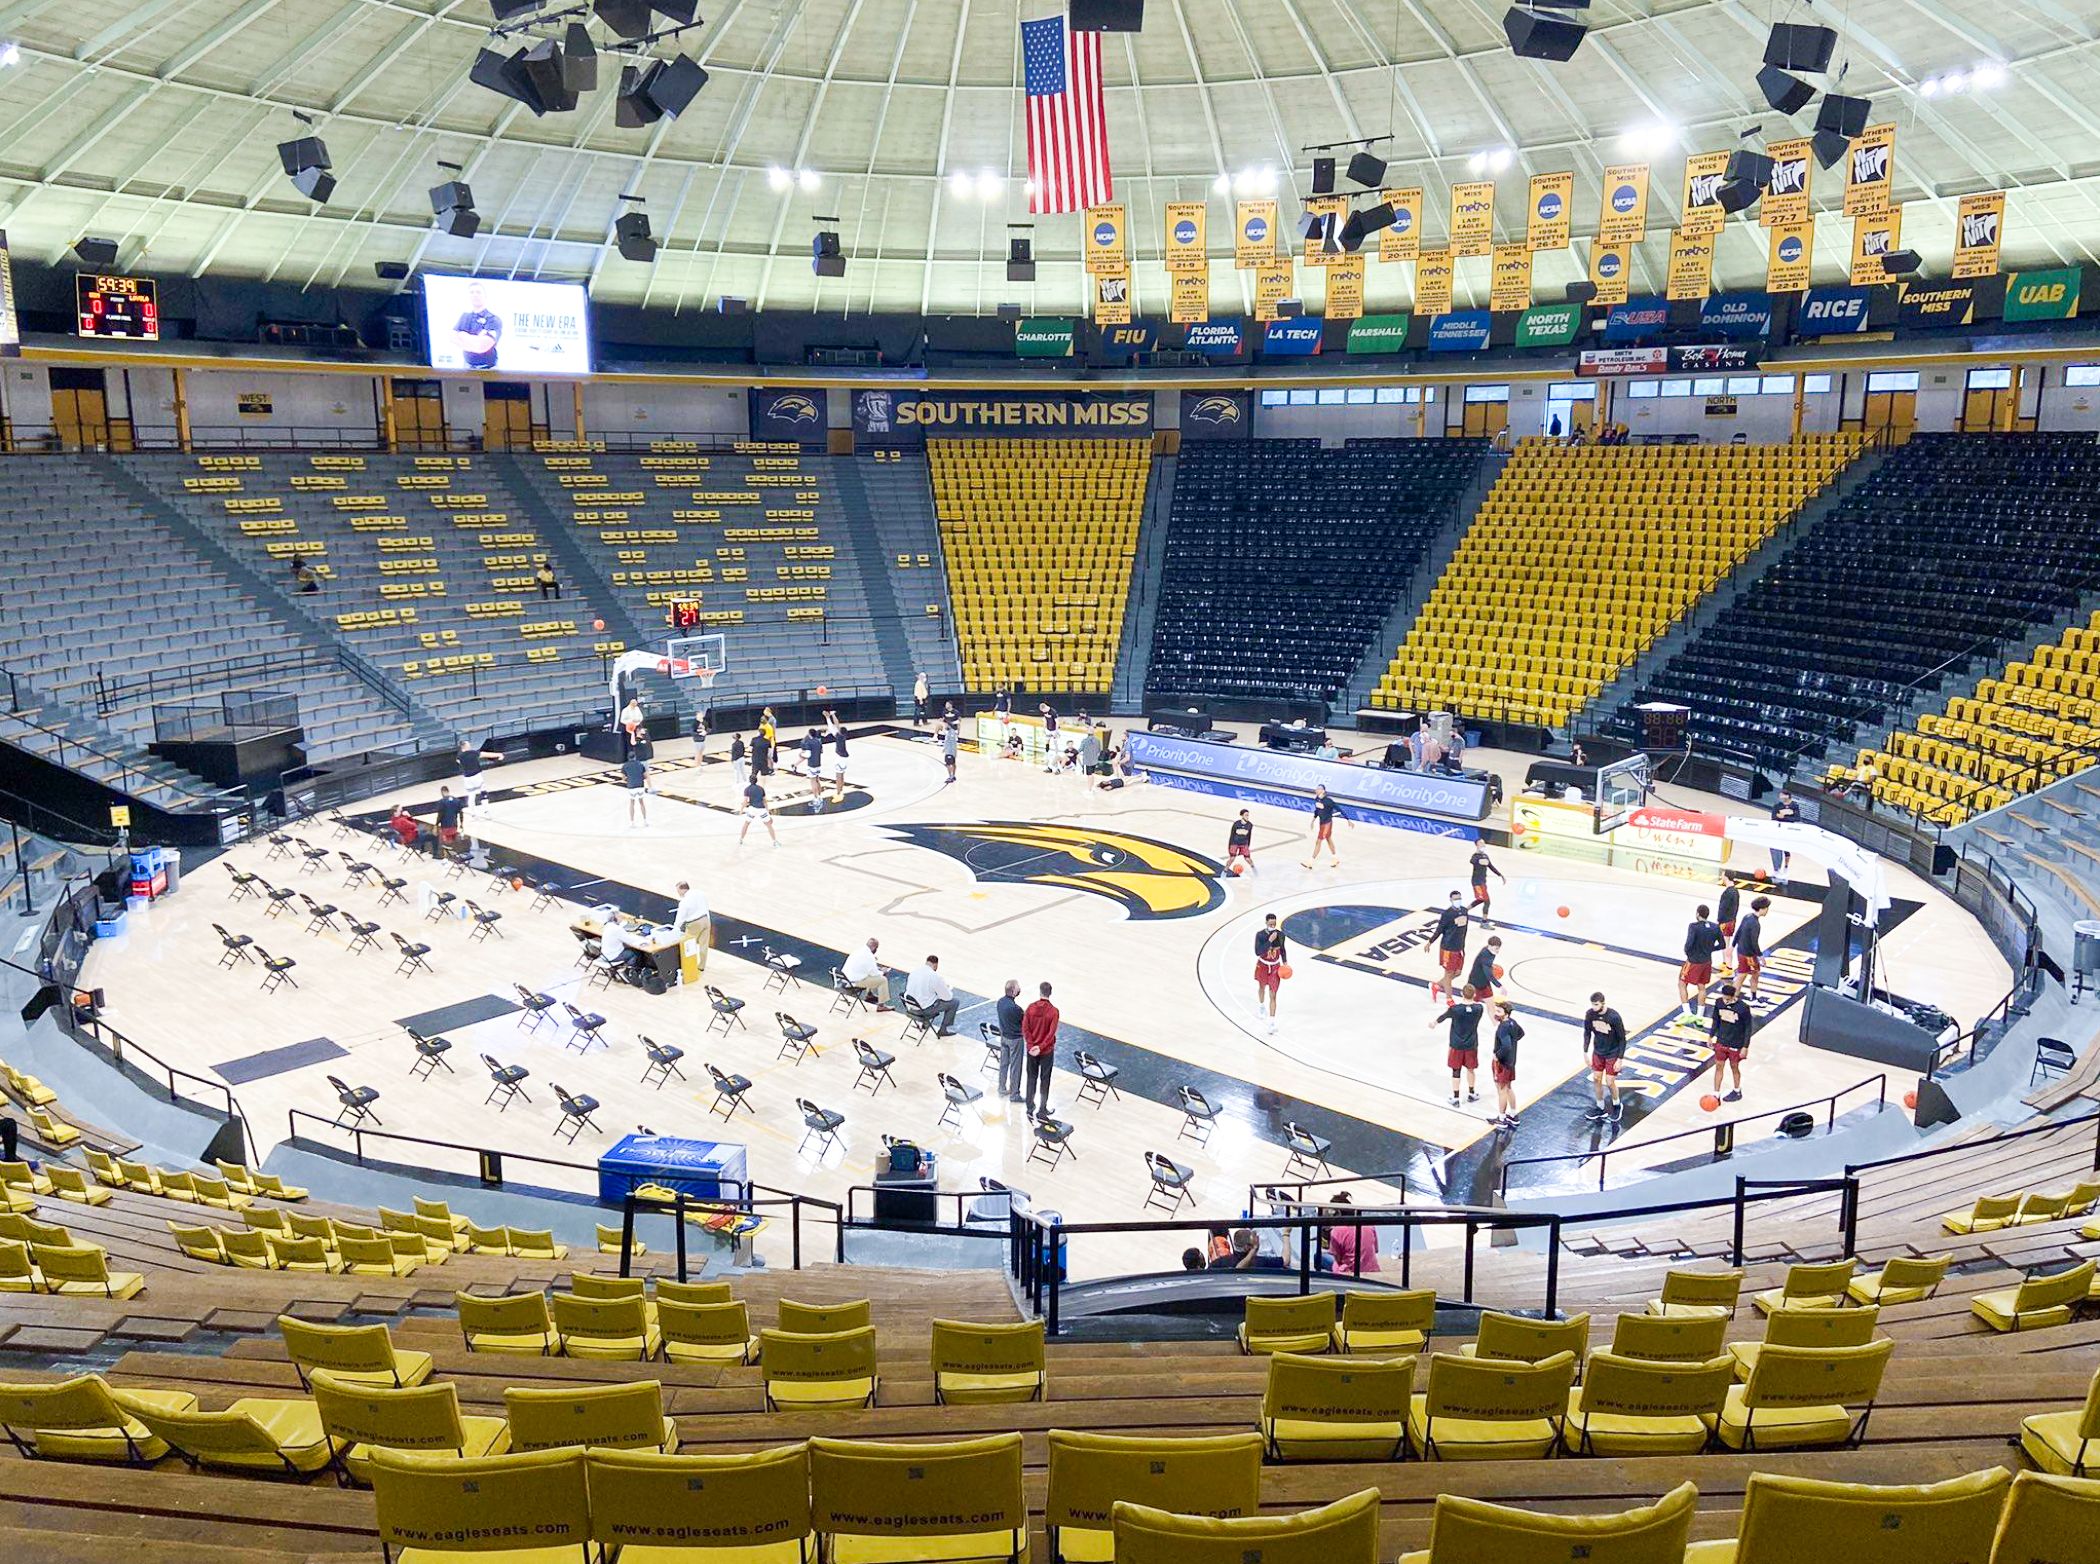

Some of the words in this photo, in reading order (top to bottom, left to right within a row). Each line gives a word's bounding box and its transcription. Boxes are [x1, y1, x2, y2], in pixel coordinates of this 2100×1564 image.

[1768, 142, 1811, 152] SOUTHERN
[1689, 154, 1729, 164] SOUTHERN
[1607, 167, 1647, 176] SOUTHERN
[1532, 176, 1571, 184] SOUTHERN
[1961, 195, 2003, 205] SOUTHERN
[1852, 204, 1880, 213] 23-11
[1771, 215, 1797, 223] 27-7
[1959, 266, 1989, 275] 25-11
[98, 277, 135, 292] 59:39
[1902, 288, 1973, 304] SOUTHERN
[2018, 283, 2067, 304] UAB
[1722, 303, 1747, 313] OLD
[1807, 299, 1863, 319] RICE
[1920, 301, 1952, 314] MISS
[513, 313, 529, 327] THE
[533, 313, 556, 328] NEW
[558, 315, 576, 329] ERA
[1441, 320, 1478, 330] MIDDLE
[1526, 312, 1571, 326] NORTH
[1702, 312, 1766, 325] DOMINION
[1113, 329, 1147, 344] FIU
[1190, 326, 1235, 335] FLORIDA
[1268, 329, 1284, 340] LA
[1286, 329, 1318, 340] TECH
[1350, 327, 1403, 337] MARSHALL
[1432, 328, 1487, 339] TENNESSEE
[1528, 324, 1568, 336] TEXAS
[1016, 332, 1073, 342] CHARLOTTE
[1187, 335, 1239, 345] ATLANTIC
[1681, 348, 1705, 361] Bok
[1715, 347, 1747, 359] Homa
[1681, 360, 1745, 369] CASINO
[240, 393, 268, 403] WEST
[1706, 396, 1737, 405] NORTH
[896, 402, 1068, 425] SOUTHERN
[1071, 402, 1150, 425] MISS
[1146, 742, 1215, 767] PriorityOne
[1256, 761, 1332, 786] PriorityOne
[1380, 781, 1468, 809] PriorityOne
[1717, 1125, 1730, 1152] J
[483, 1154, 498, 1181] L
[772, 1365, 867, 1378] www.eagleseats.com
[942, 1360, 1034, 1371] www.eagleseats.com
[1281, 1405, 1402, 1417] www.eagleseats.com
[1441, 1402, 1561, 1417] www.eagleseats.com
[1597, 1399, 1717, 1412] www.eagleseats.com
[330, 1423, 447, 1446] www.eagleseats.com
[830, 1509, 1006, 1529] www.eagleseats.com
[391, 1522, 571, 1542] www.eagleseats.com
[611, 1517, 789, 1540] www.eagleseats.com
